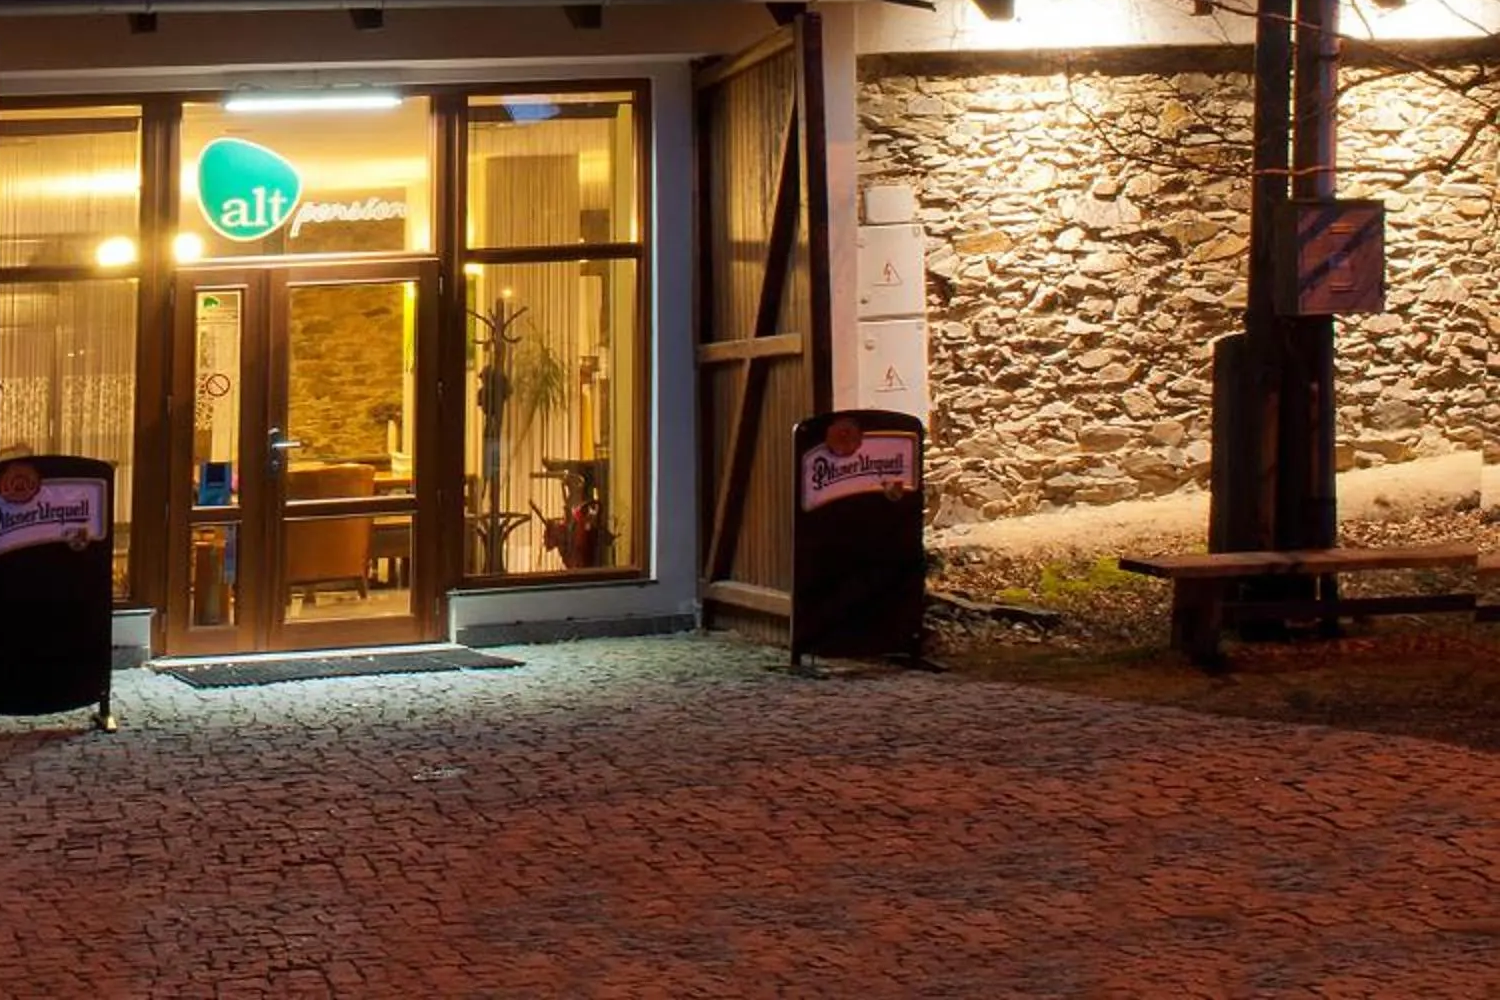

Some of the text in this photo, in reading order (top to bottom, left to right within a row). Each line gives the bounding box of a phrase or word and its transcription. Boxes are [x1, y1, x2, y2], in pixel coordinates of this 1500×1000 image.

[221, 186, 408, 238] alt pension
[37, 499, 90, 524] Urquell
